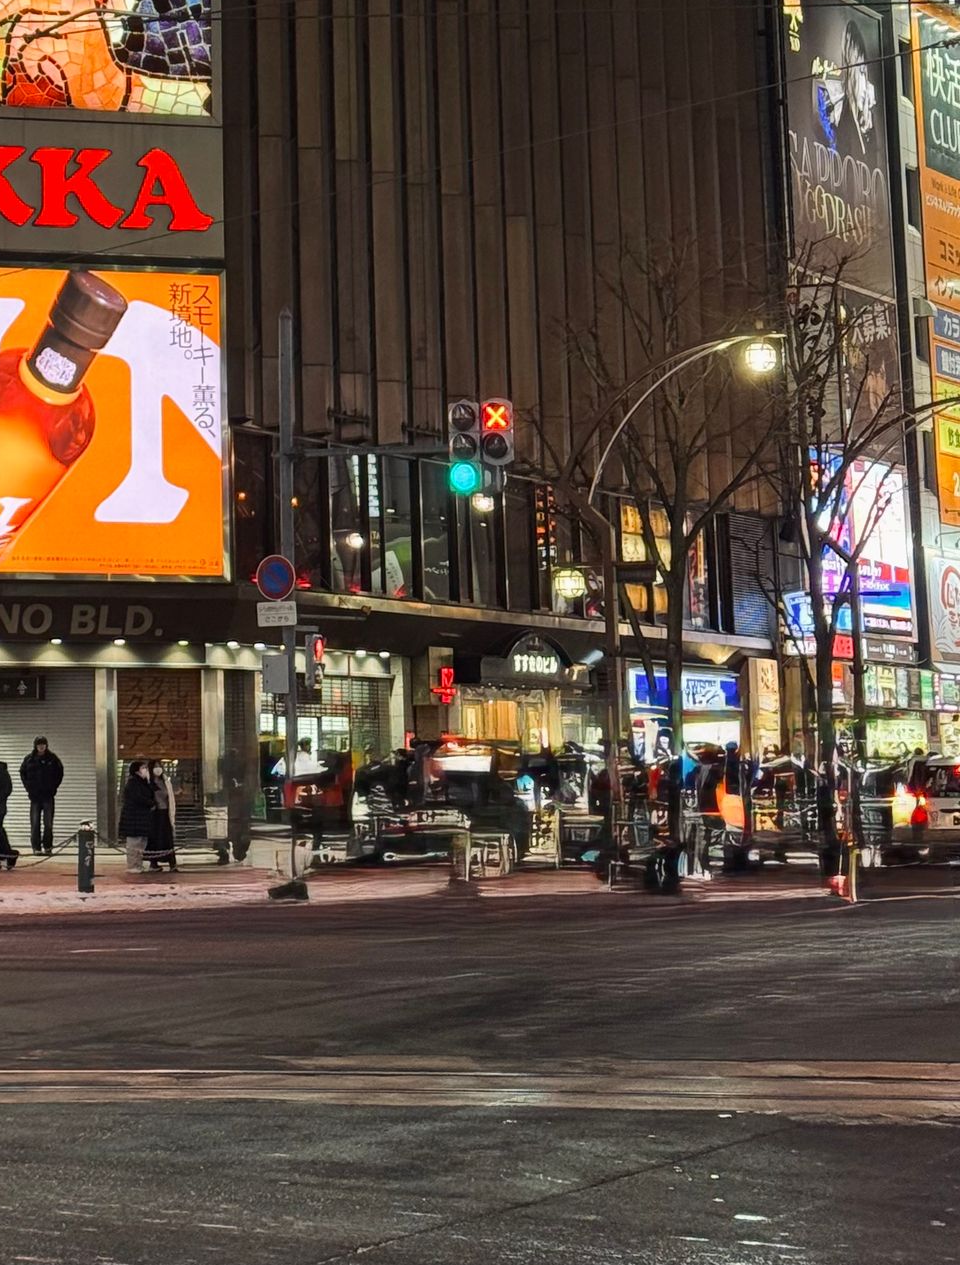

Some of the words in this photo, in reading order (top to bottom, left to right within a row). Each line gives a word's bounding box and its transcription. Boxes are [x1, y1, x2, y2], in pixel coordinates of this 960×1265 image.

[169, 281, 193, 361] 新境地。
[192, 284, 217, 438] スモーキー薫る、
[70, 604, 163, 636] BLD.
[513, 653, 558, 674] すすきのビル
